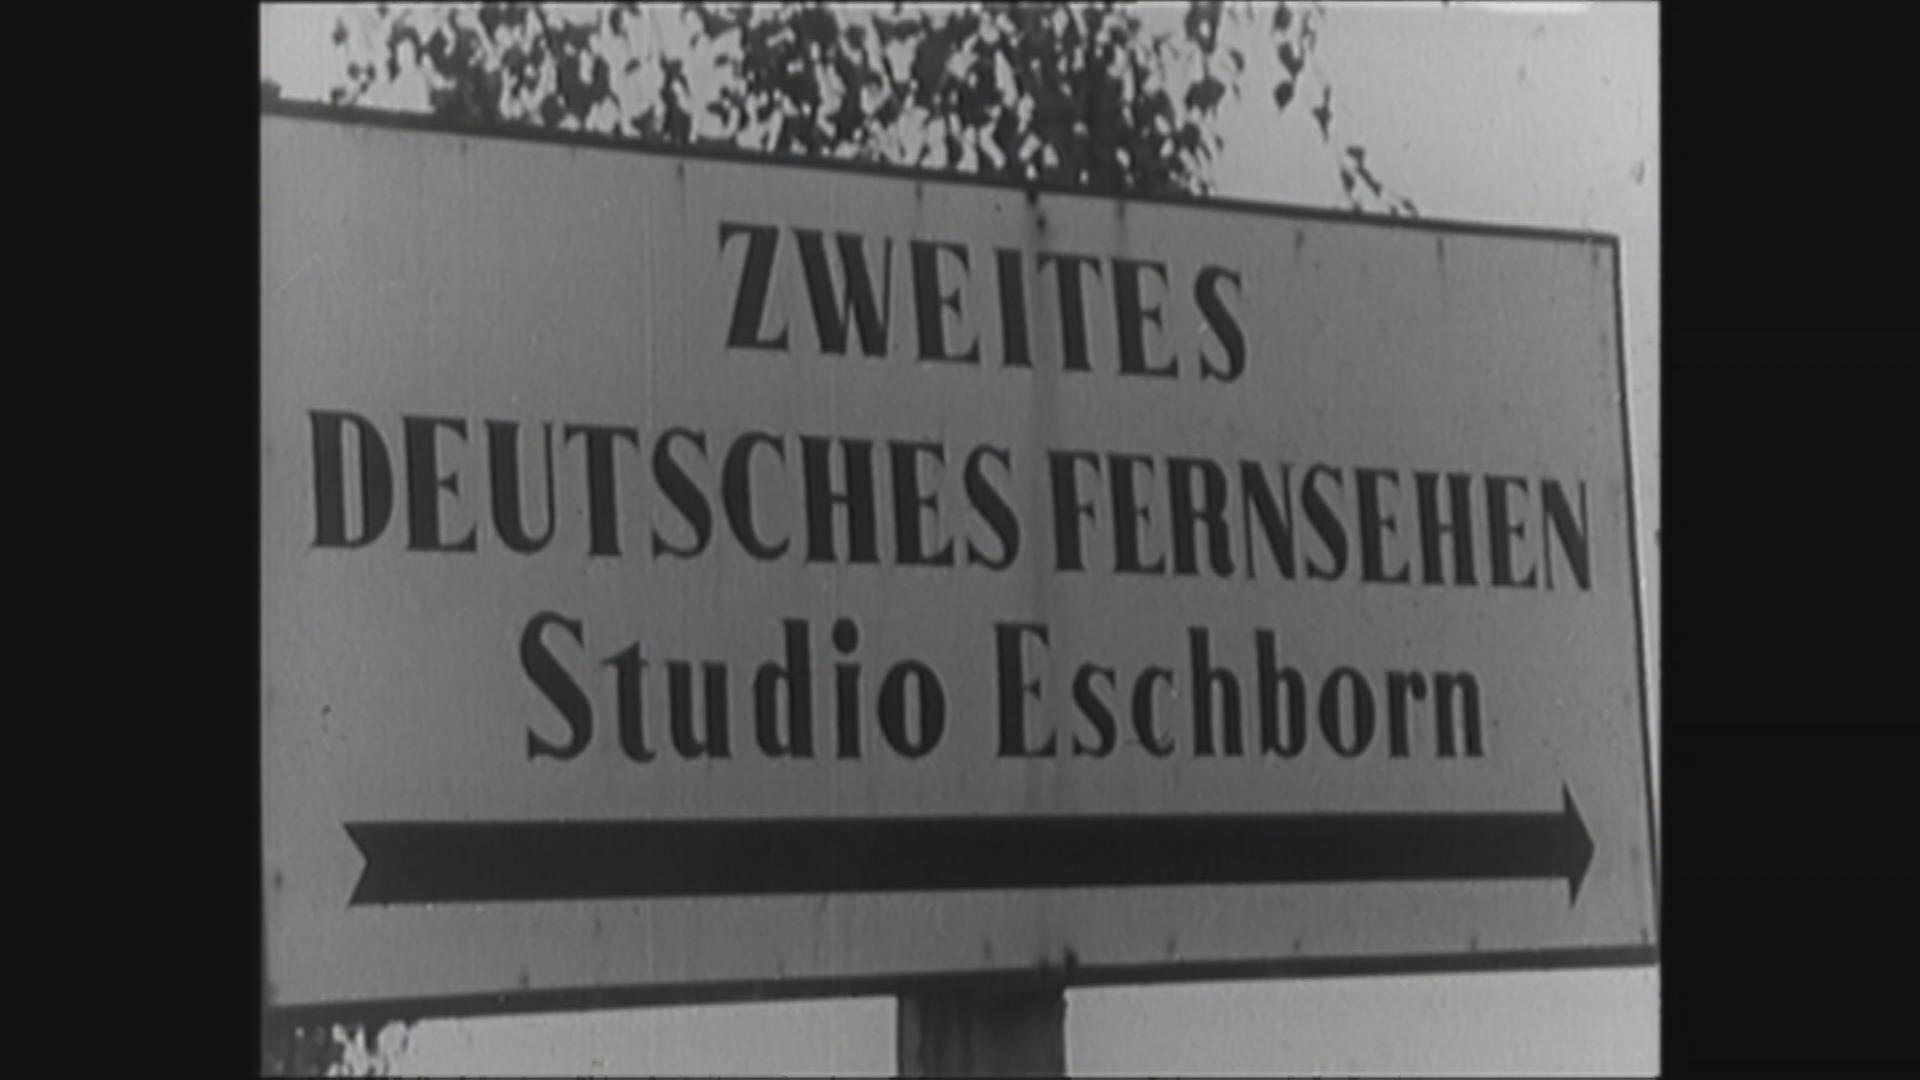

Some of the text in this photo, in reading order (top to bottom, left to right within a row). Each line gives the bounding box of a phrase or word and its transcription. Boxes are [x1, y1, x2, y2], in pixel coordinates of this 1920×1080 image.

[718, 221, 1247, 384] ZWEITES
[308, 410, 1593, 591] DEUTSCHES FERNSEHEN
[518, 610, 1485, 763] Studio Eschborn
